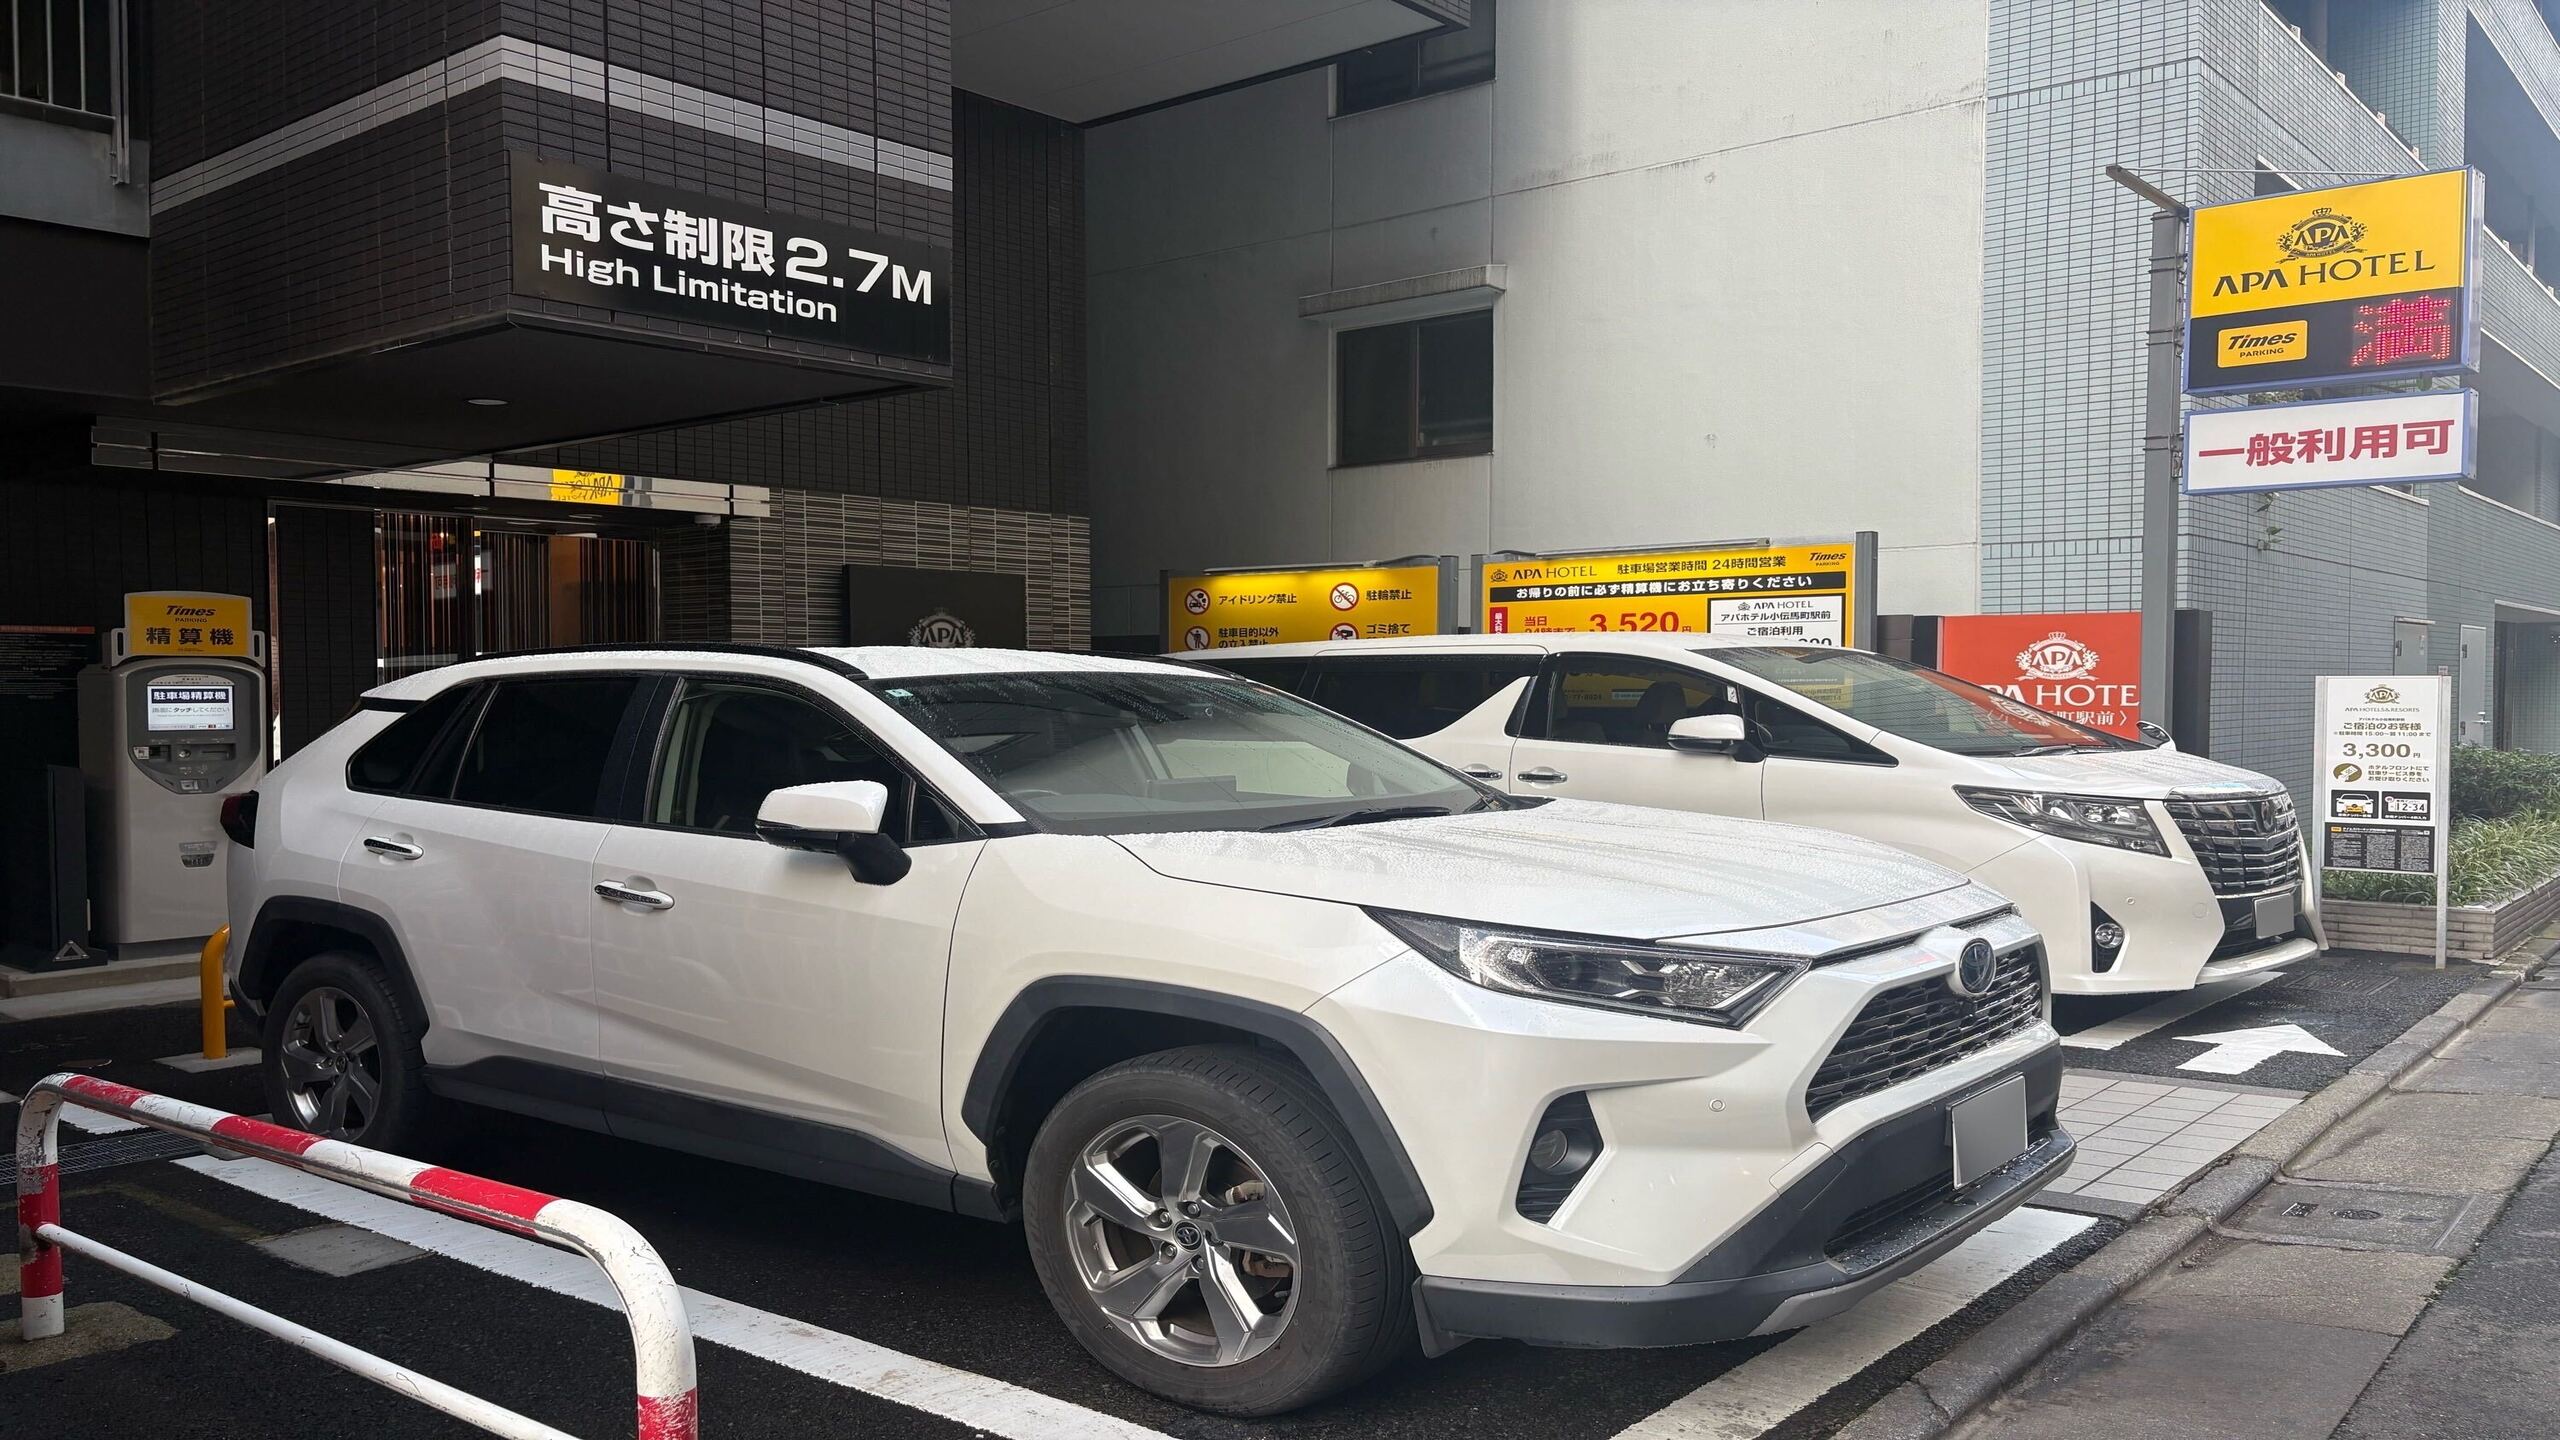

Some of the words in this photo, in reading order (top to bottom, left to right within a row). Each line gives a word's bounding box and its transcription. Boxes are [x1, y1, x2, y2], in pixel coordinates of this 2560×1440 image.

[2212, 268, 2289, 297] APA
[2299, 250, 2436, 286] HOTEL
[541, 244, 640, 288] High
[653, 265, 838, 323] Limitation
[2351, 294, 2451, 366] 満
[2227, 331, 2298, 351] Times
[2239, 347, 2285, 358] PARKING
[2198, 419, 2455, 467] 一般利用可
[1808, 552, 1847, 561] Times
[1617, 560, 1707, 575] 駐車場営業時間
[1712, 556, 1787, 571] 24時間営業
[1513, 568, 1542, 580] APA
[1546, 565, 1597, 579] HOTEL
[1516, 575, 1812, 599] お帰りの前に必ず精算機にお立ち寄りください
[1218, 593, 1297, 606] アイドリング禁止
[1366, 588, 1412, 601] 駐輪禁止
[166, 605, 217, 617] Times
[1753, 602, 1775, 610] APA
[1777, 601, 1814, 609] HOTEL
[1524, 615, 1548, 627] 当日
[1218, 627, 1279, 638] 駐車目的以外
[1366, 623, 1411, 634] ゴミ捨て
[1747, 625, 1803, 636] ご宿泊利用
[146, 627, 234, 645] 精算機
[921, 628, 964, 643] APA
[153, 691, 227, 700] 駐車場精算機
[2343, 722, 2422, 731] ご宿泊のお客様
